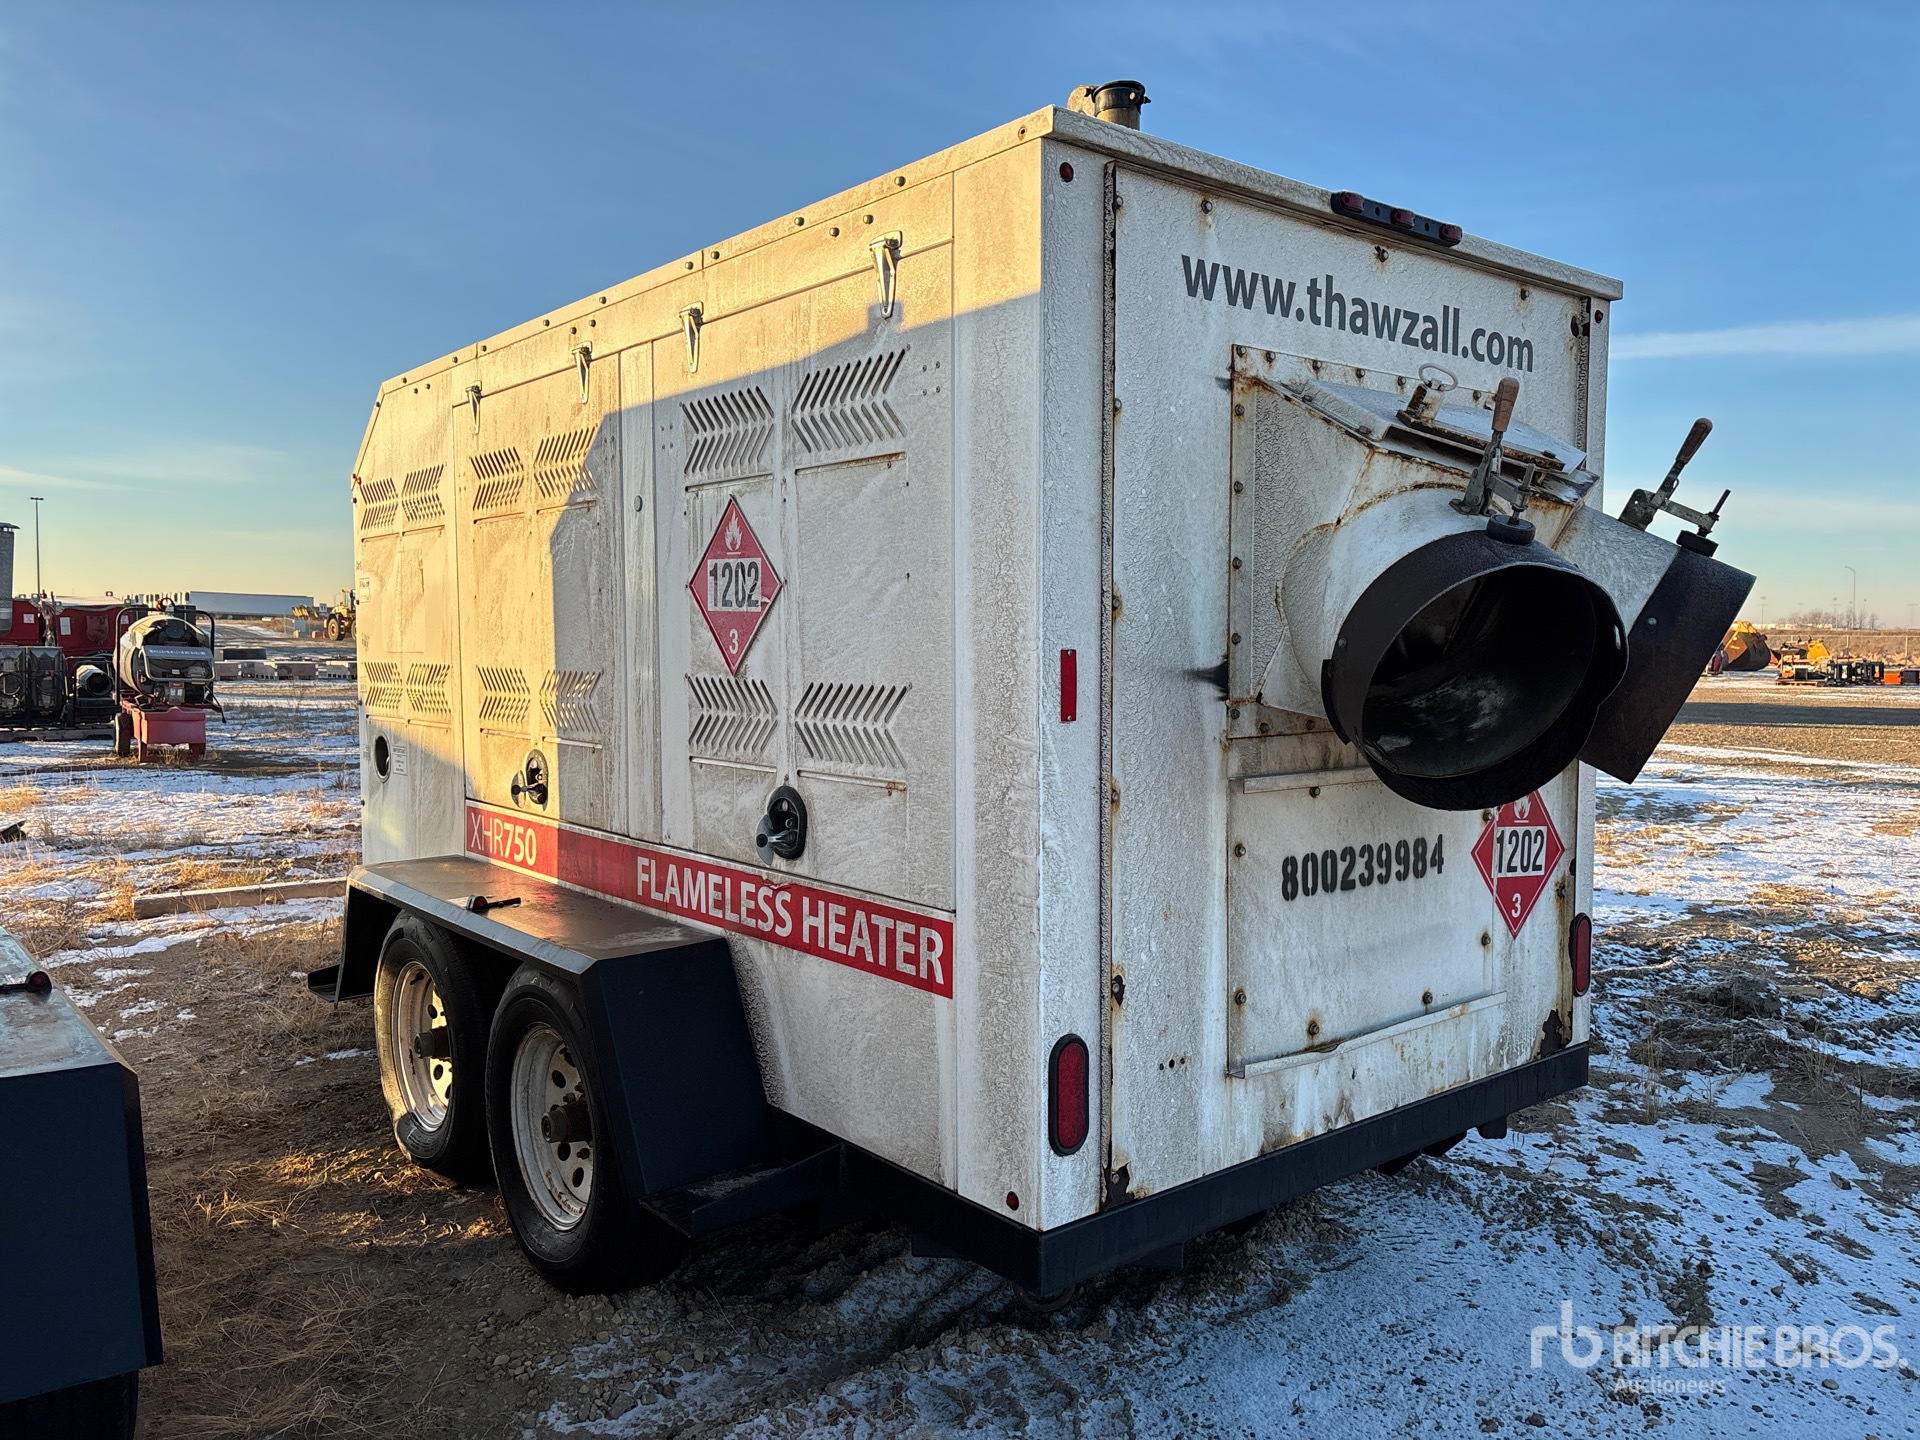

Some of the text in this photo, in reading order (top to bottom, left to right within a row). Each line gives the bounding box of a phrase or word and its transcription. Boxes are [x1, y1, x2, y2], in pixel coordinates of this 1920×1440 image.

[1181, 254, 1534, 373] www.thawzall.com
[709, 561, 760, 608] 1202
[729, 628, 739, 655] 3
[470, 812, 537, 867] XHR750
[1496, 829, 1545, 873] 1202
[1281, 833, 1444, 901] 800239984
[637, 856, 945, 985] FLAMELESS HEATER
[1511, 892, 1522, 918] 3
